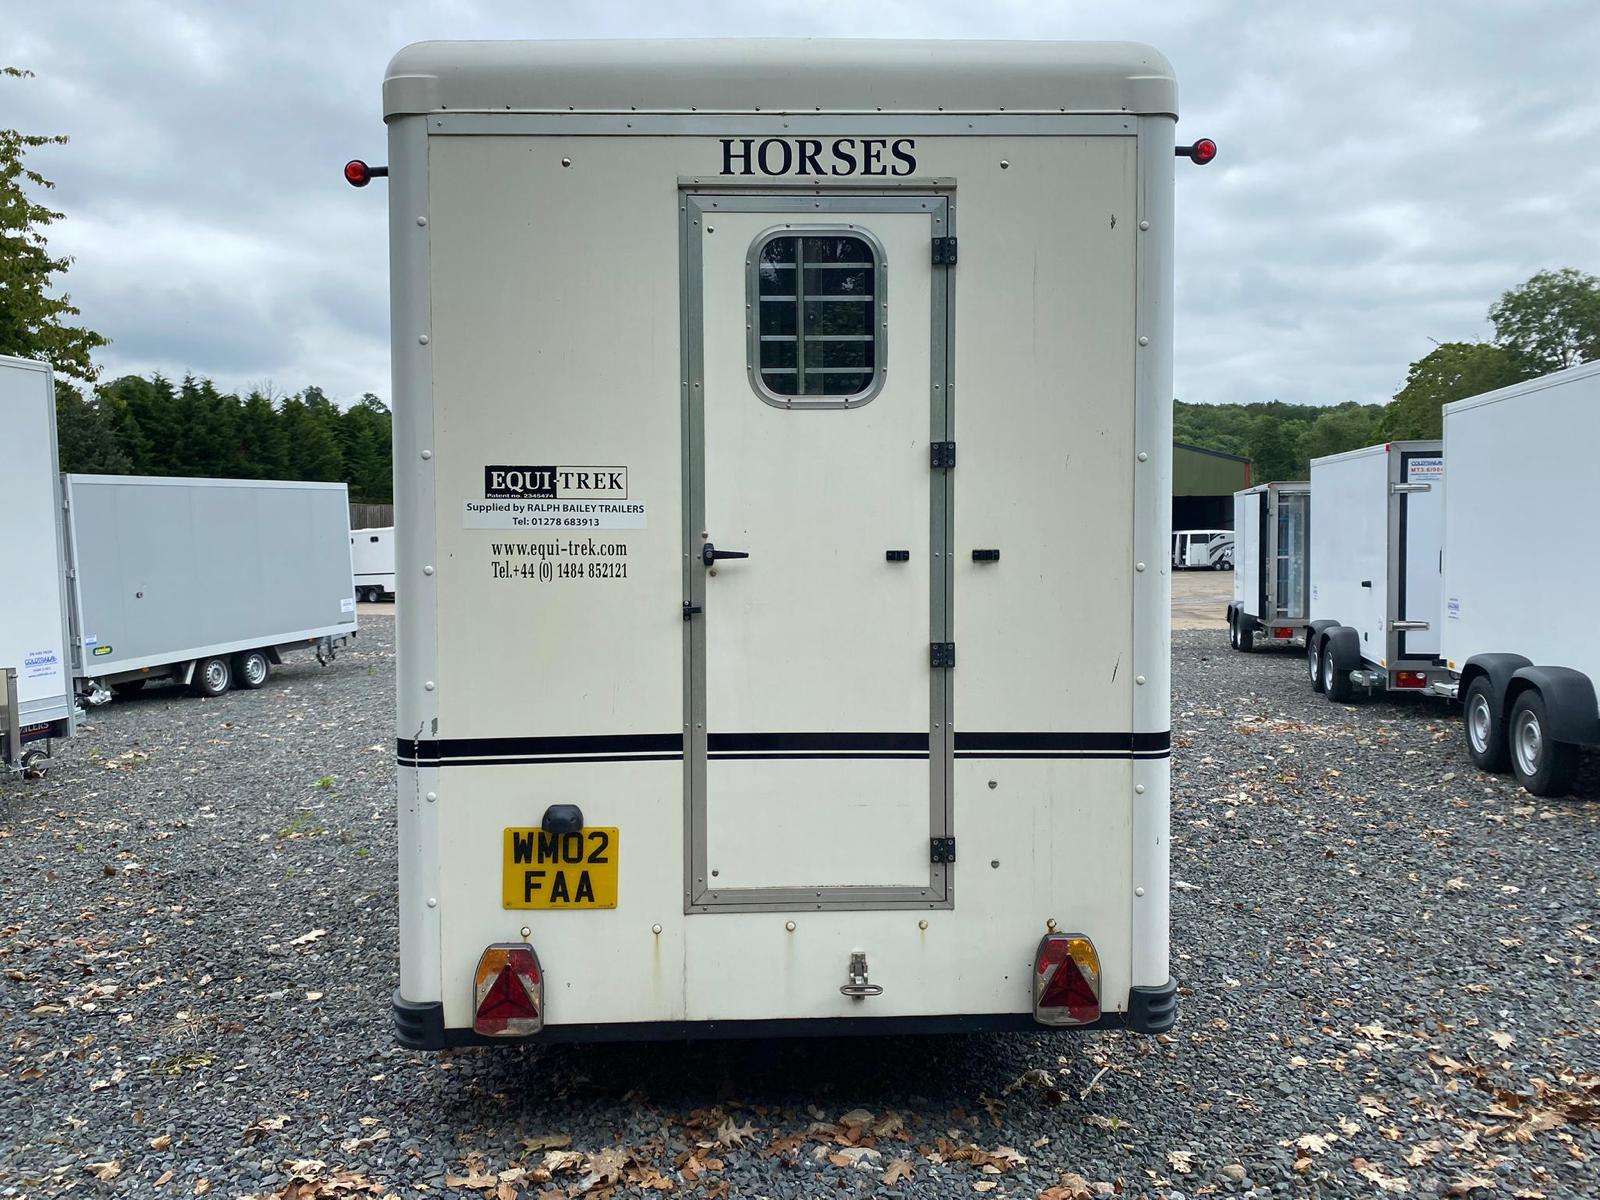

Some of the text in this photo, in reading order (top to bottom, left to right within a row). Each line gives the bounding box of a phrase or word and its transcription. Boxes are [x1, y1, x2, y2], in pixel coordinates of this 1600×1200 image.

[719, 138, 917, 176] HORSES
[491, 471, 624, 492] EQUI-TREK
[466, 502, 645, 513] Supplied by RALPH BAILEY TRAILERS
[512, 517, 600, 526] Tel: 01278 683913
[491, 538, 627, 560] www.equi-trek.com
[539, 561, 553, 582] (0)
[557, 563, 584, 578] 1484
[588, 563, 627, 578] 852121
[513, 831, 609, 864] WM02
[524, 870, 595, 903] FAA
